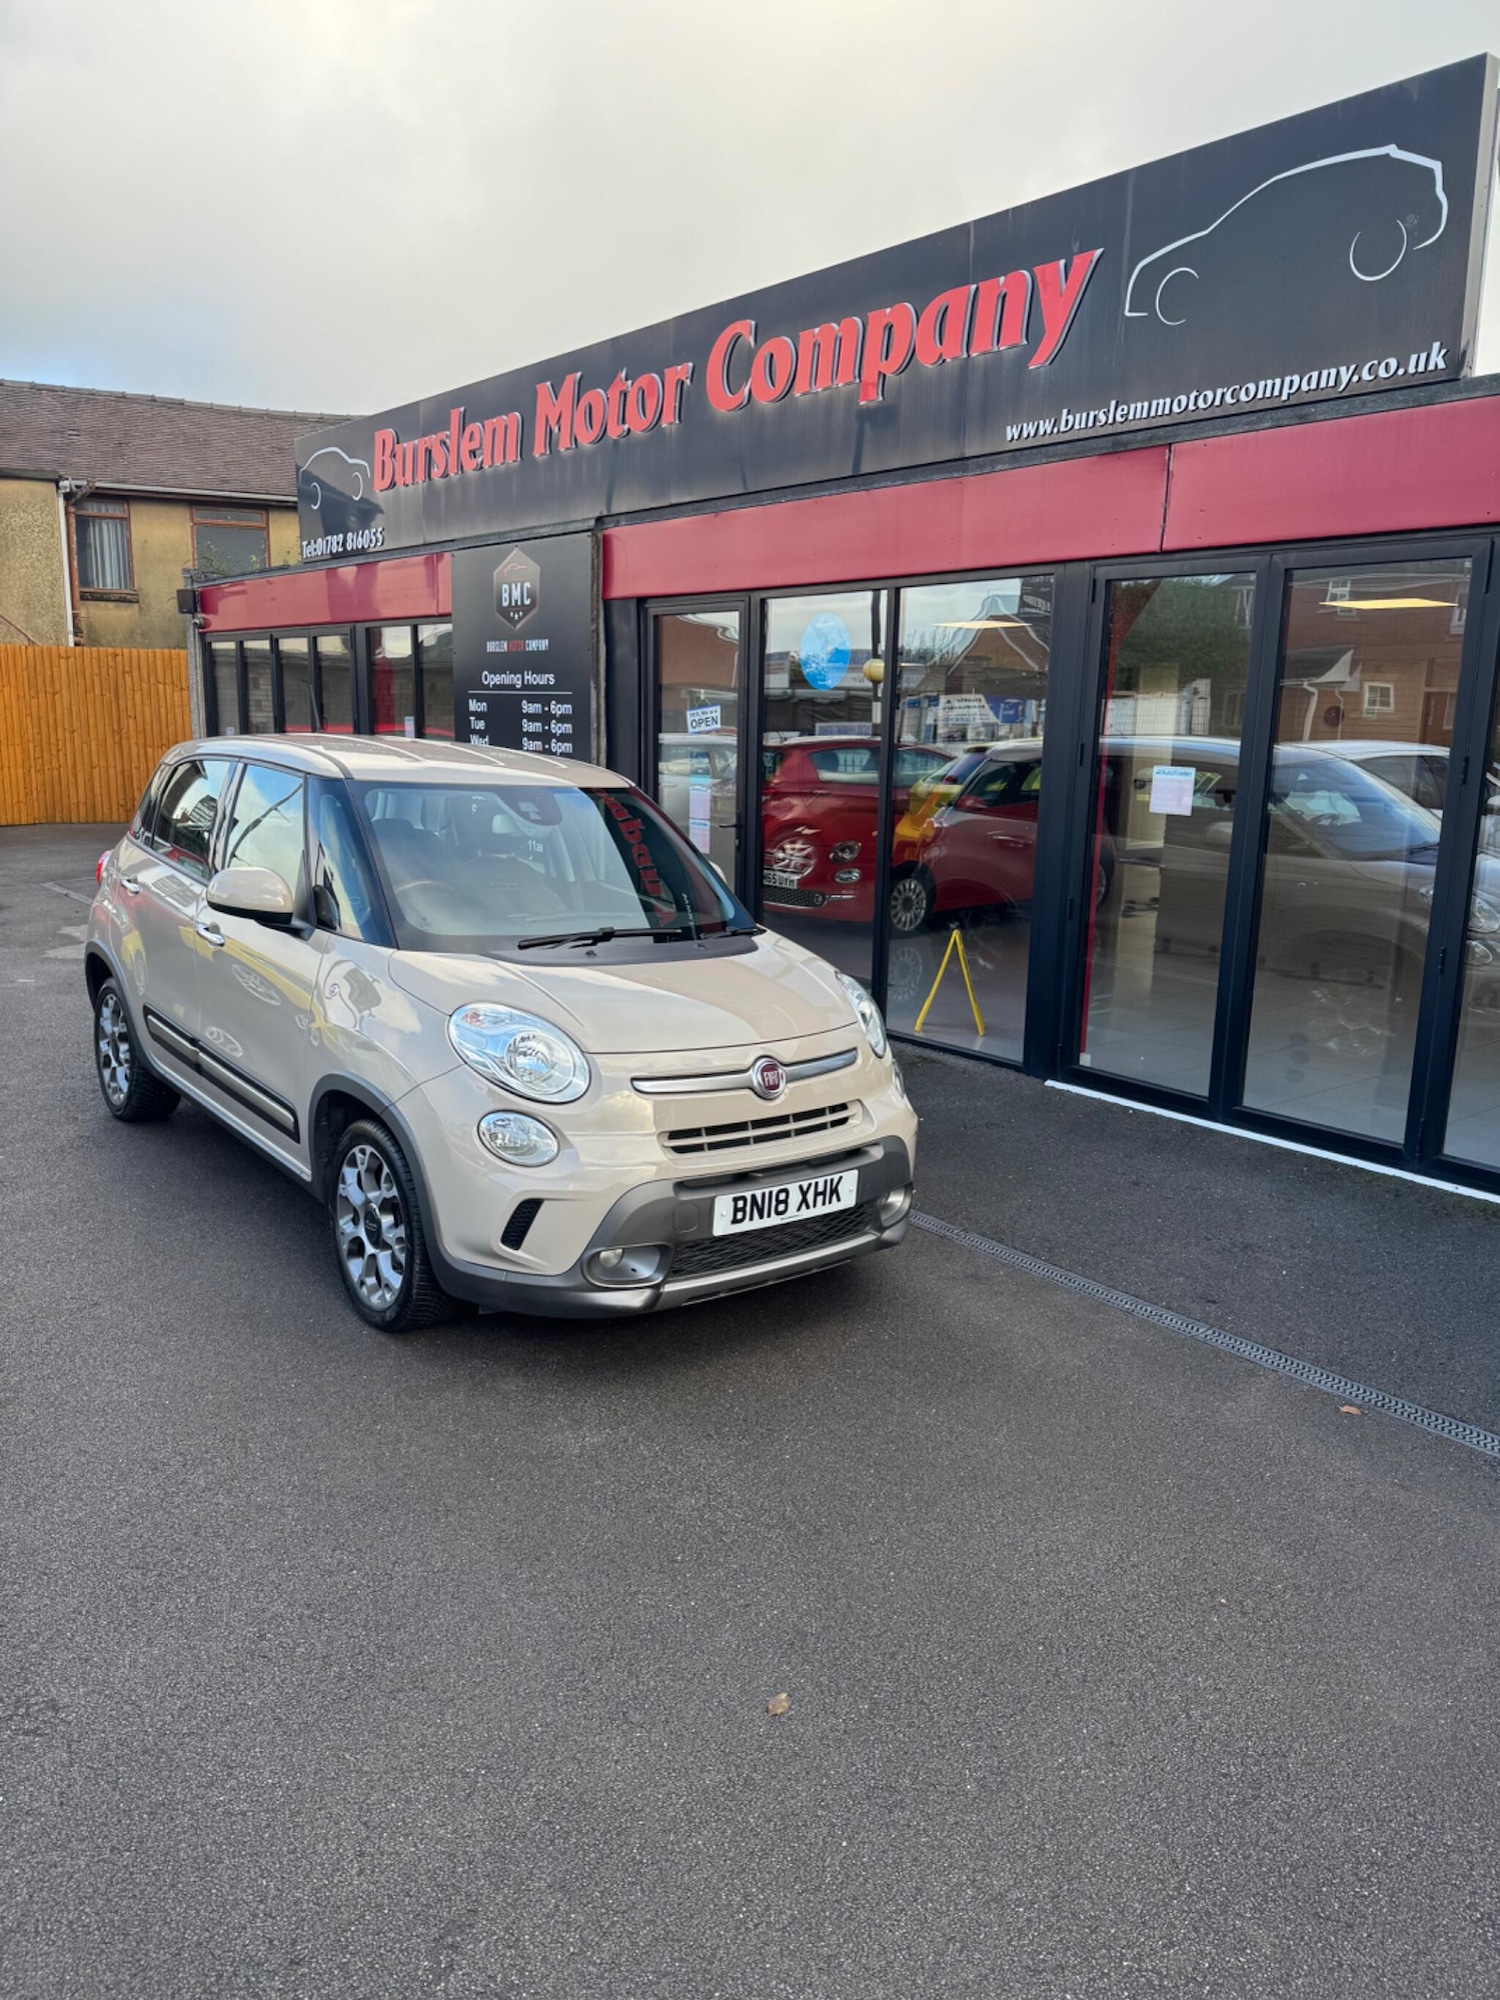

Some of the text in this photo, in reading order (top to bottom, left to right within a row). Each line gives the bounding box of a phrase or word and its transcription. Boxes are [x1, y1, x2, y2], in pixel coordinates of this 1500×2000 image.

[373, 247, 1104, 492] Burslem Motor Company
[1005, 341, 1449, 442] www.burslemmotorcompany.co.uk
[346, 527, 385, 551] 816055
[502, 582, 531, 607] BMC
[487, 640, 508, 652] BURSLEM
[525, 639, 549, 651] COMPANY
[482, 671, 555, 688] Opening Hours
[469, 699, 487, 711] Mon
[521, 700, 542, 713] 9am
[550, 701, 572, 717] 6pm
[469, 717, 485, 729] Tue
[522, 719, 542, 732] 9am
[550, 720, 572, 736] 6pm
[690, 716, 719, 729] OPEN
[470, 735, 489, 747] Wed
[522, 738, 543, 751] 9am
[551, 739, 572, 755] 6pm
[763, 1071, 778, 1086] FIAT
[731, 1175, 843, 1225] BN18 XHK
